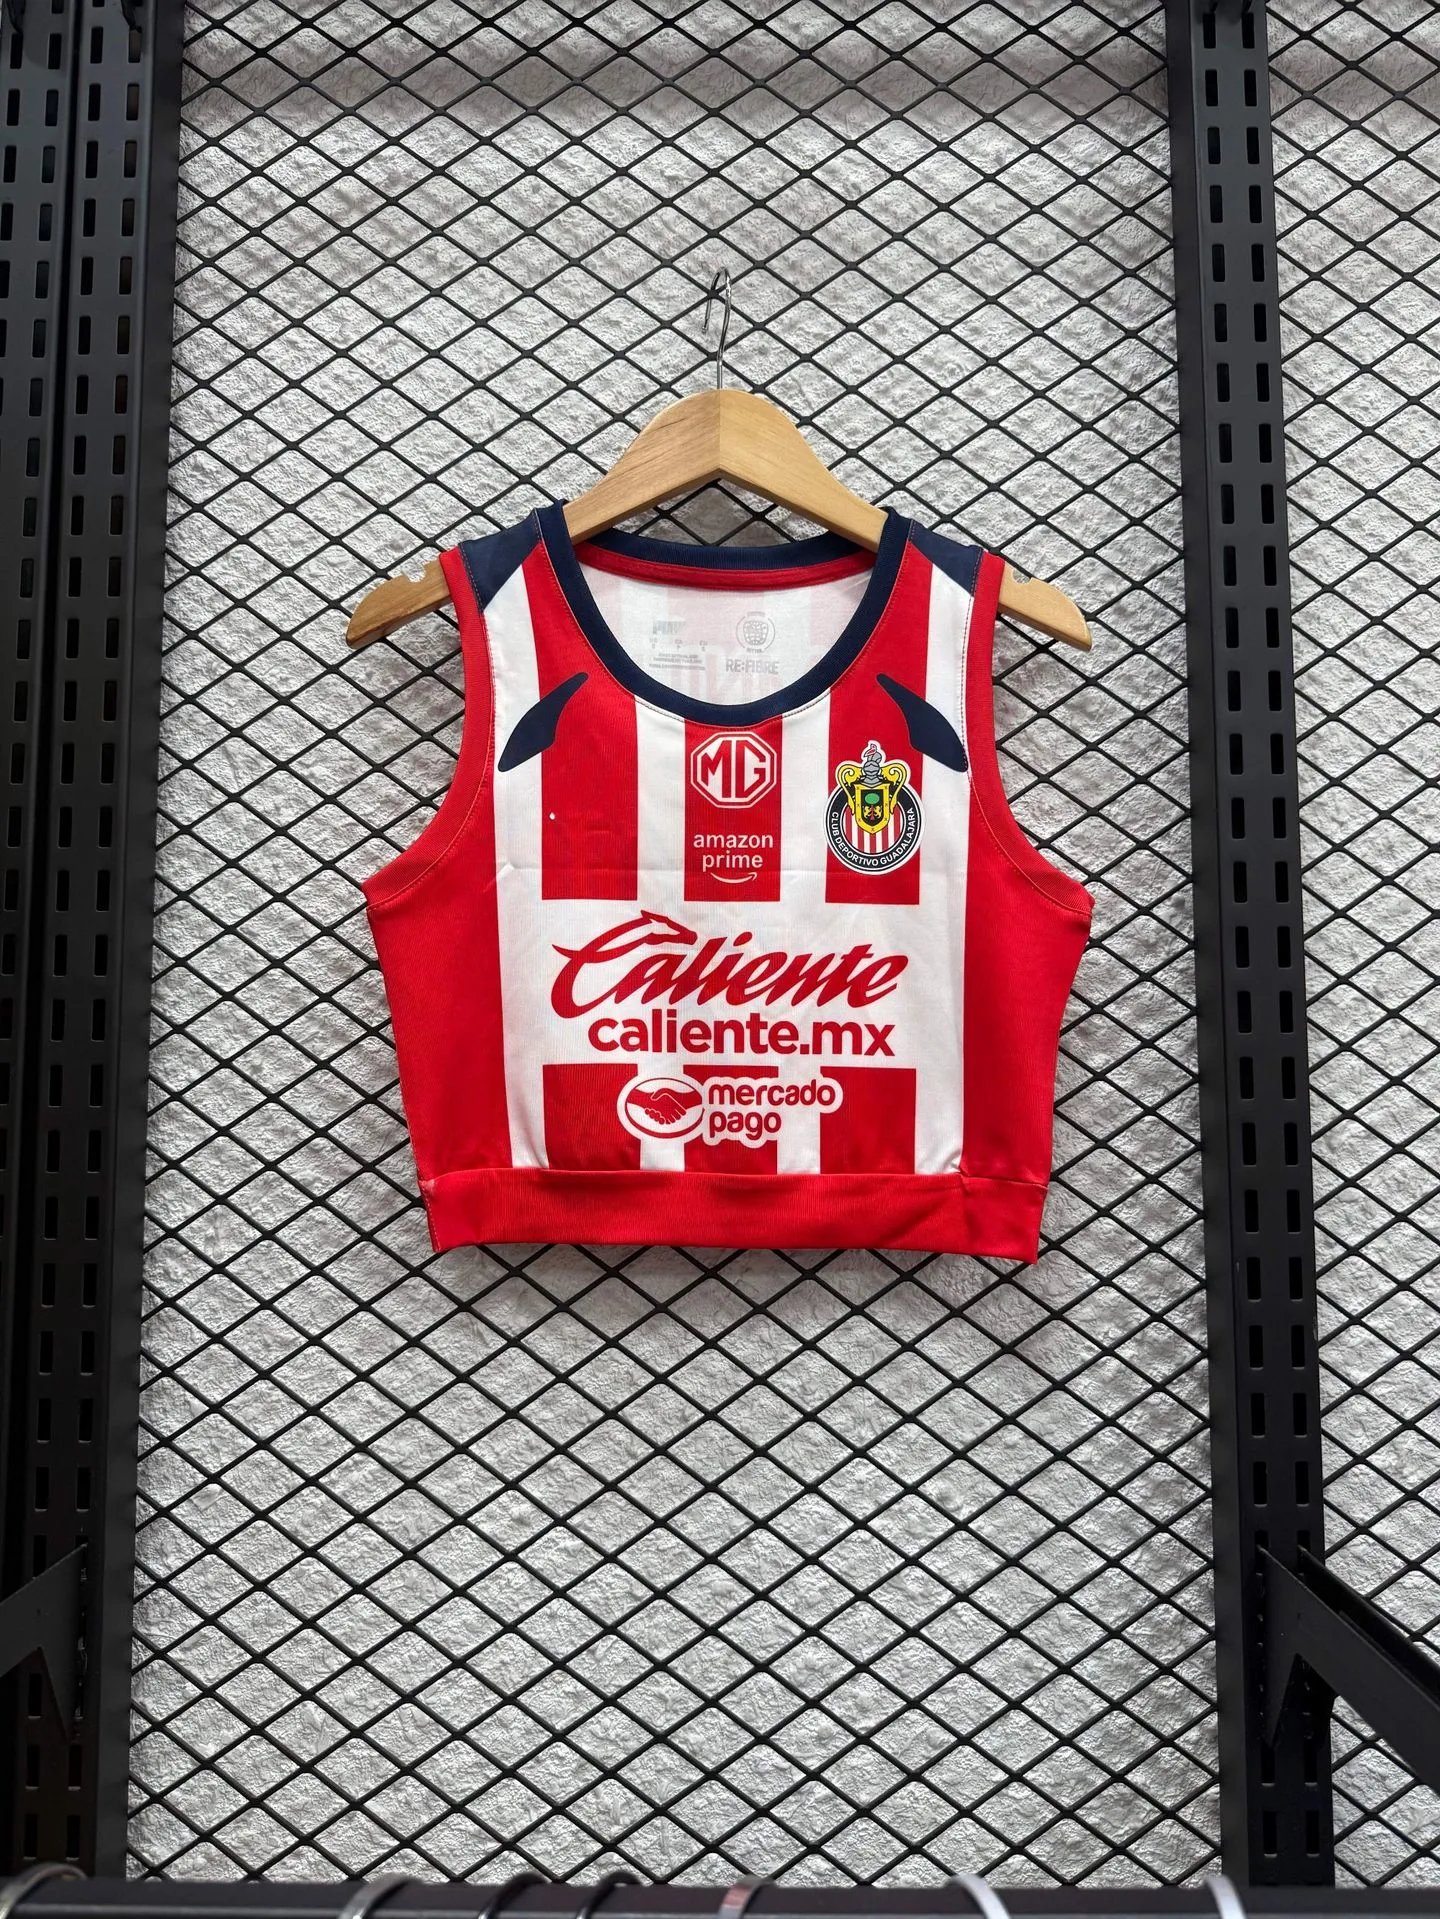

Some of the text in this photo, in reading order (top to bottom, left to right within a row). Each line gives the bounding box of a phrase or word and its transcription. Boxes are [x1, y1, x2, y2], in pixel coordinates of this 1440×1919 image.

[726, 658, 780, 675] RE:FIBRE
[700, 739, 768, 800] MG
[693, 833, 774, 849] amazon
[831, 807, 916, 867] CLUB DEPORTIVO GUADALAJARA
[702, 850, 764, 872] prime
[551, 910, 909, 1019] Caliente
[588, 1008, 895, 1057] caliente.mx
[708, 1078, 836, 1107] mercado
[709, 1109, 782, 1139] pago
